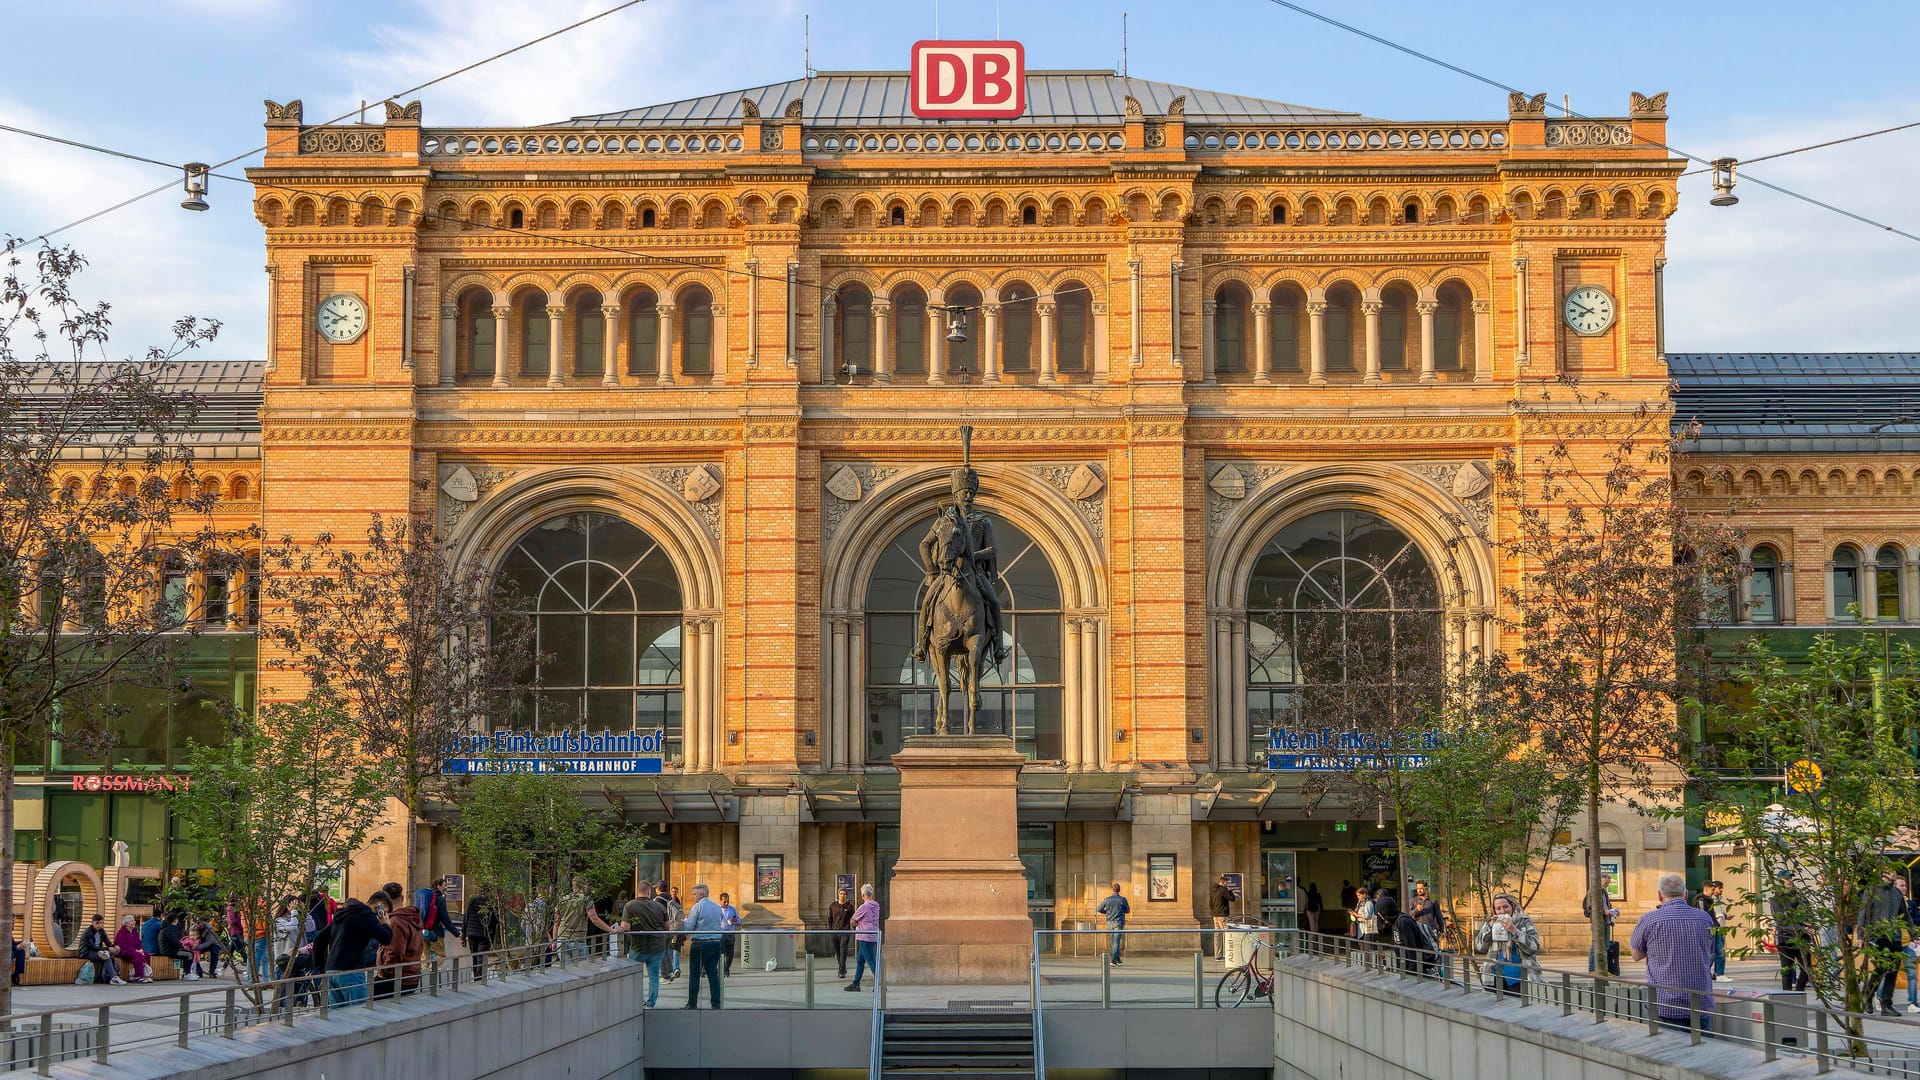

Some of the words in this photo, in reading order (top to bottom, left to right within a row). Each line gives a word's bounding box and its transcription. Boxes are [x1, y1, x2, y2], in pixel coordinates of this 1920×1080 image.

[927, 53, 1012, 104] DB
[495, 729, 664, 753] Einkaufsbahnhof
[468, 760, 534, 772] HANNOVER
